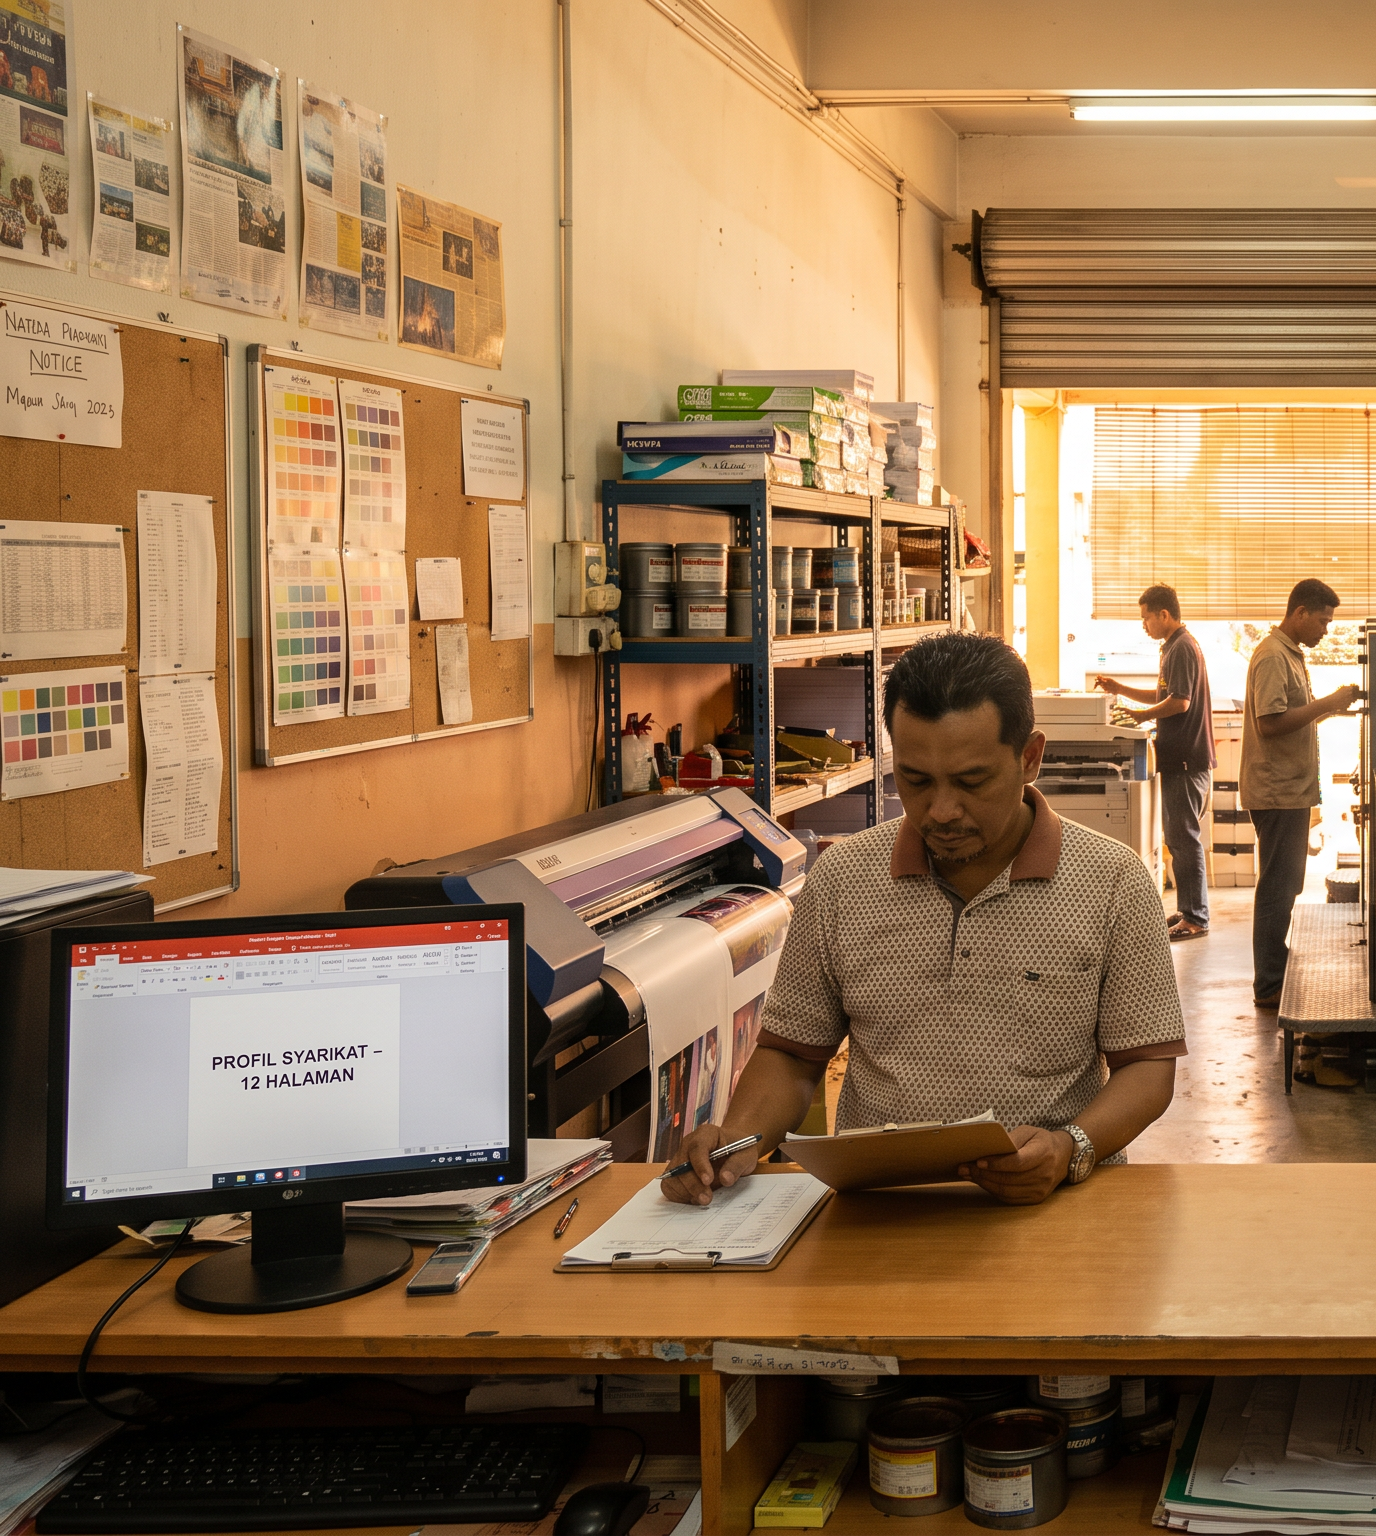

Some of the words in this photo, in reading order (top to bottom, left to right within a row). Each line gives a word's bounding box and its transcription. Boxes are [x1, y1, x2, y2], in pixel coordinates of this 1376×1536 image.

[30, 349, 82, 373] NOTICE
[212, 1052, 277, 1070] PROFIL
[282, 1045, 368, 1065] SYARIKAT
[241, 1076, 260, 1090] 12
[266, 1067, 354, 1089] HALAMAN
